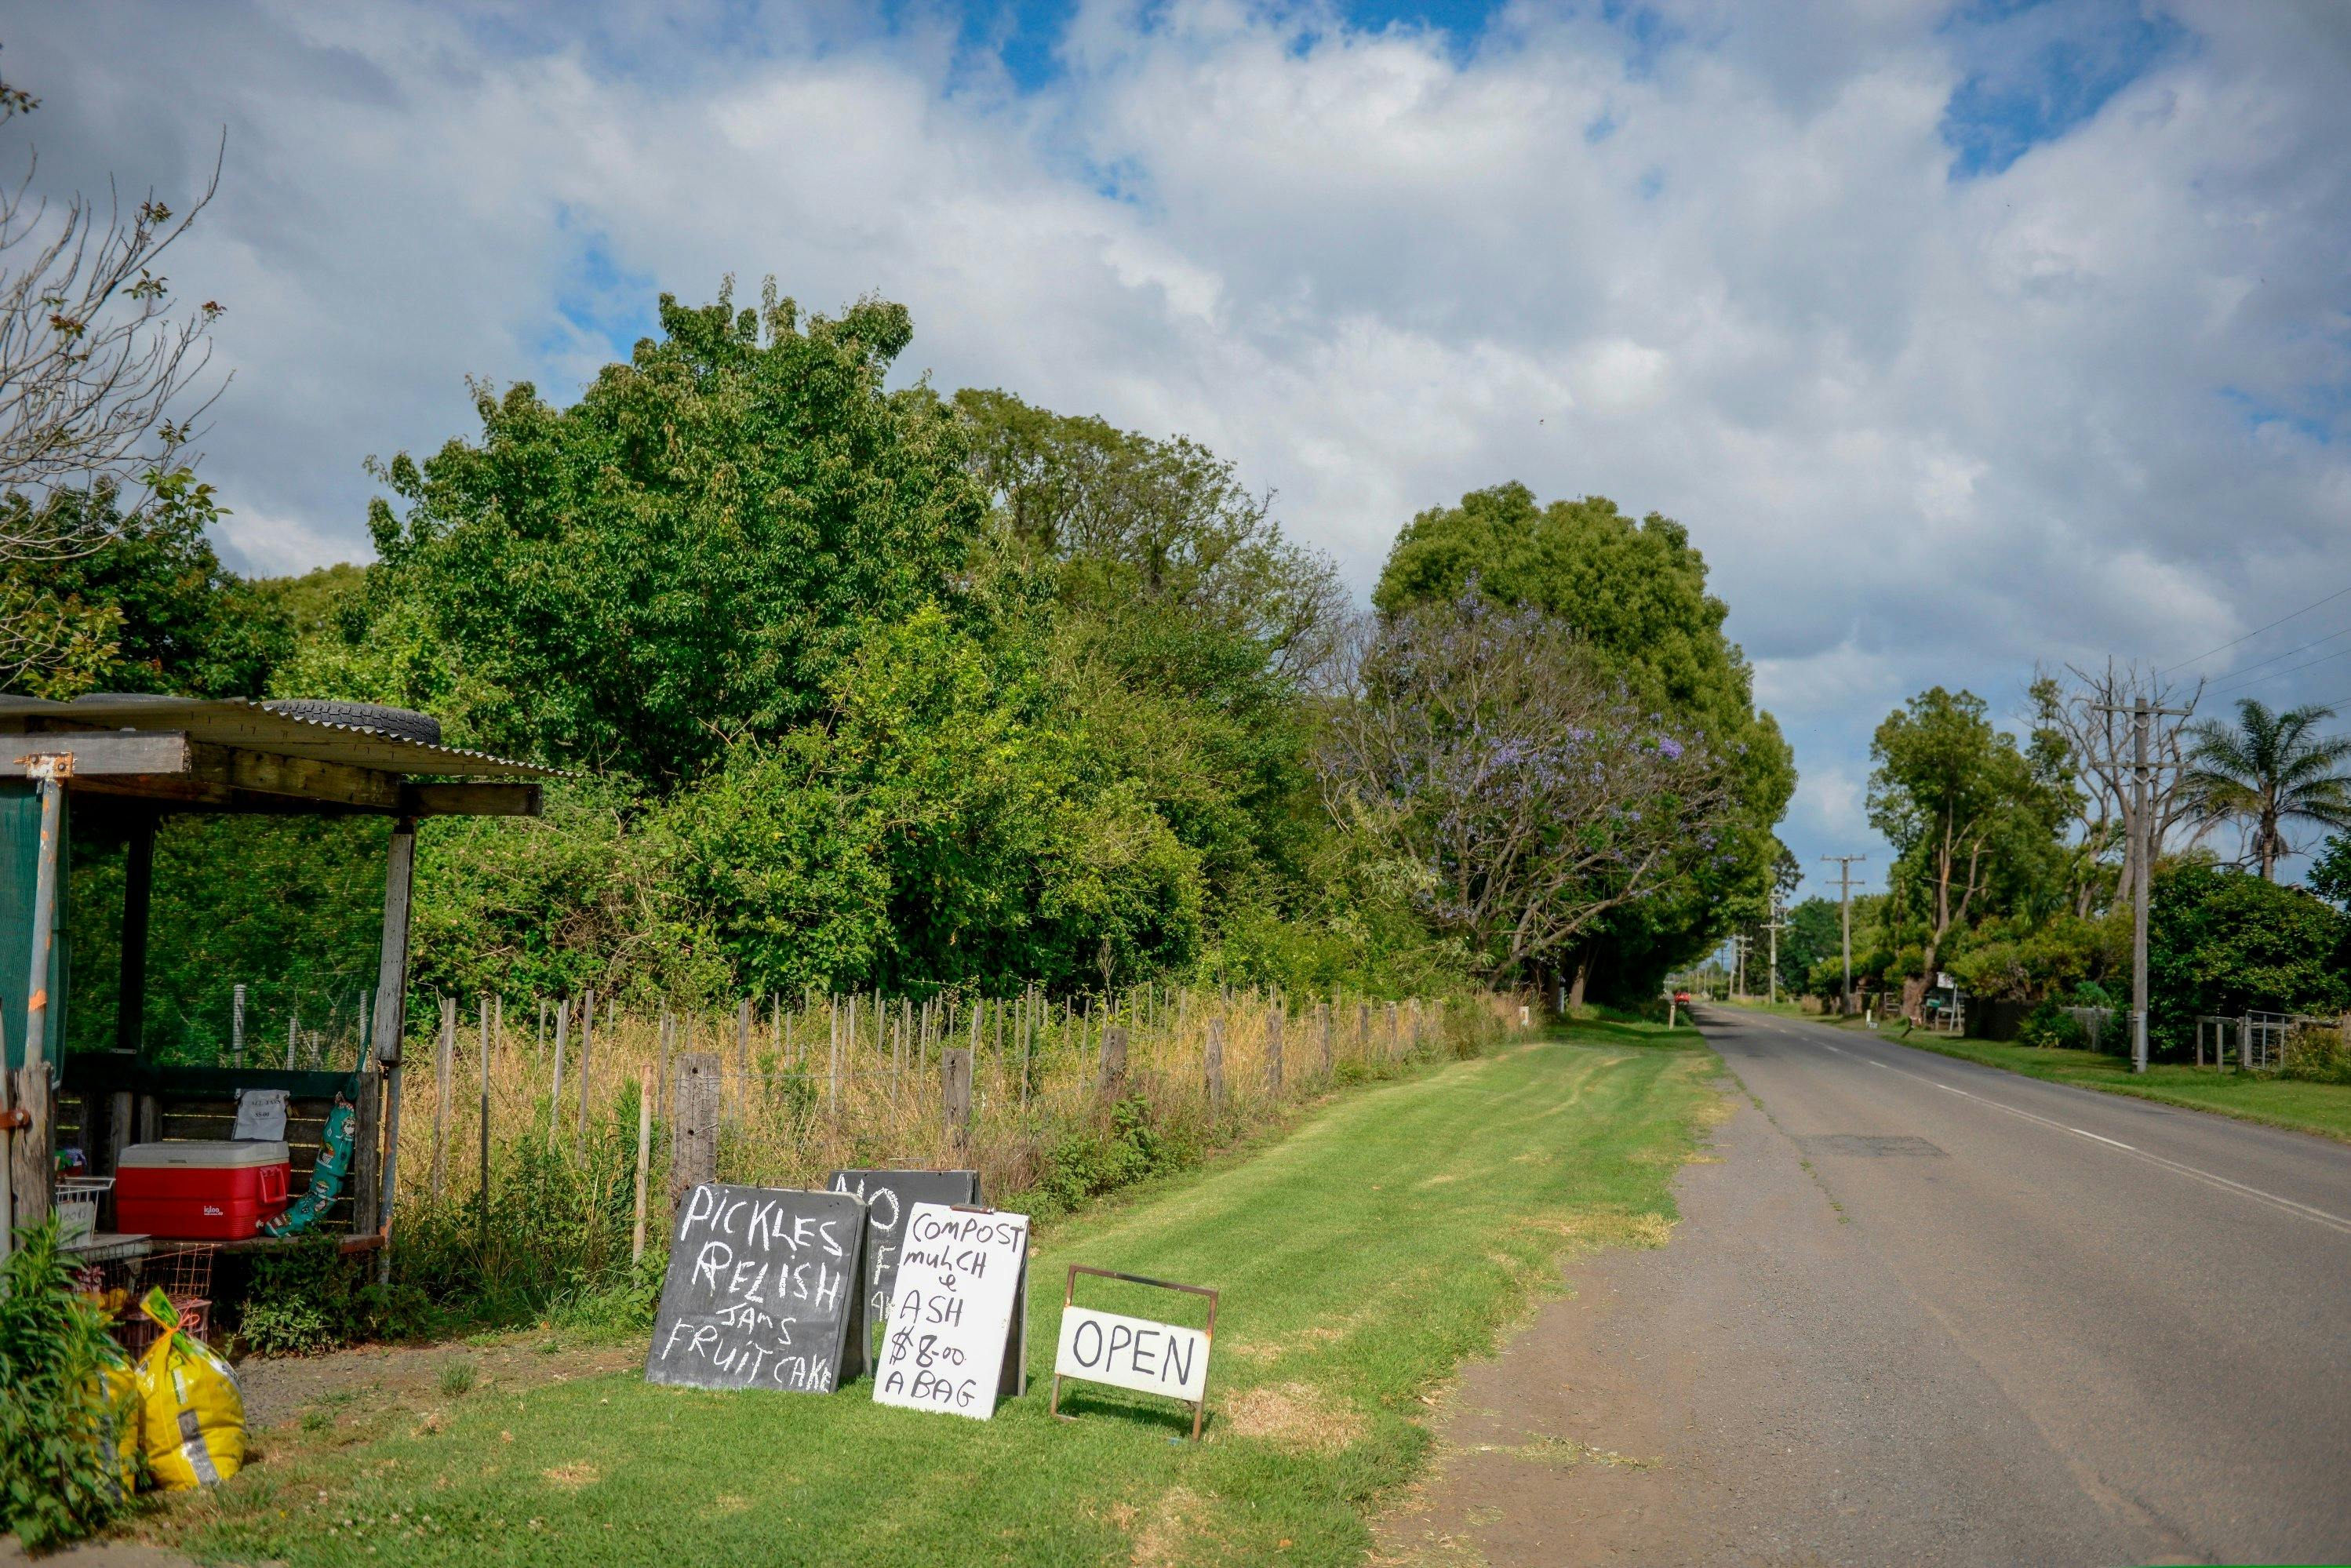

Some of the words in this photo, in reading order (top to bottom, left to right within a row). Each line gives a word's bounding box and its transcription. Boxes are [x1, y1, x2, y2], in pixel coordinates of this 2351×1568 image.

[681, 1184, 843, 1257] PICKLES
[913, 1213, 1024, 1253] COMPOST
[691, 1240, 840, 1312] RELISH
[716, 1302, 796, 1344] JAMS
[900, 1290, 963, 1327] ASH
[661, 1318, 773, 1383] FRUIT
[774, 1354, 832, 1393] CAKE
[1073, 1320, 1195, 1385] OPEN
[885, 1370, 904, 1395] A
[911, 1370, 977, 1407] BAG
